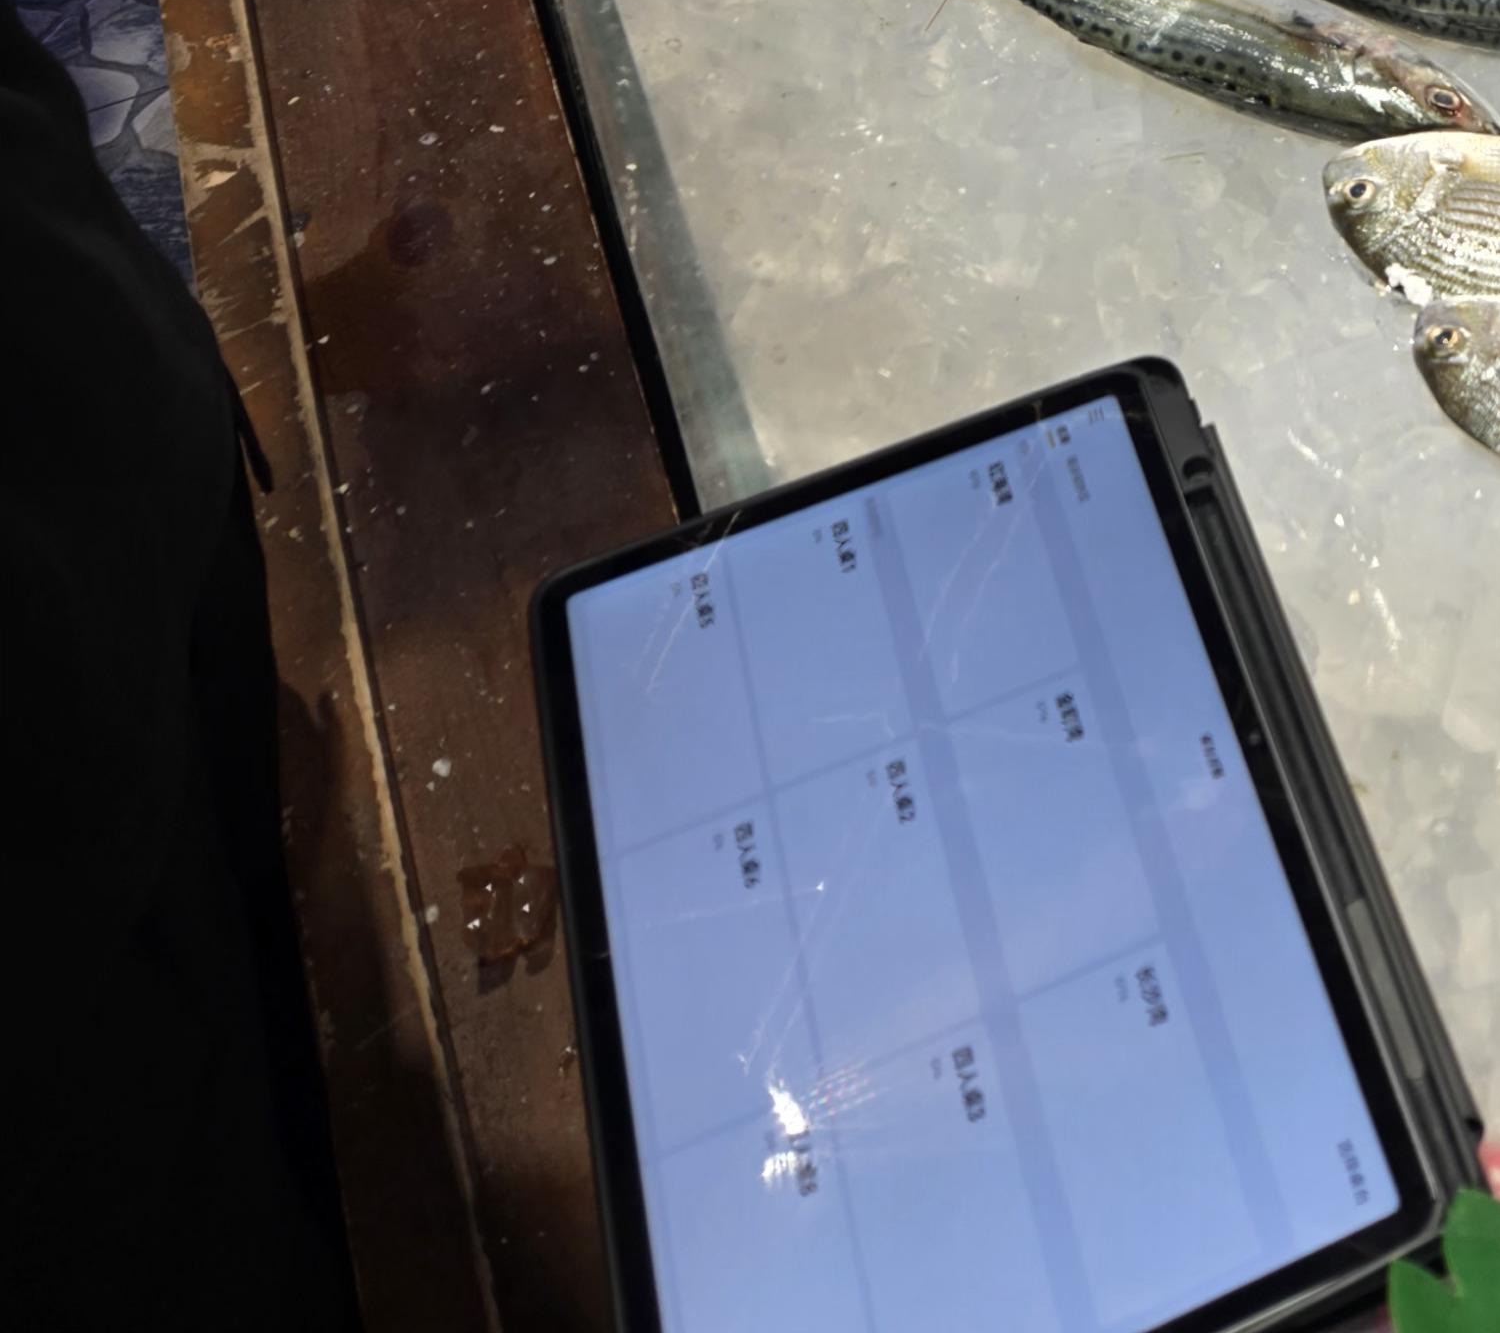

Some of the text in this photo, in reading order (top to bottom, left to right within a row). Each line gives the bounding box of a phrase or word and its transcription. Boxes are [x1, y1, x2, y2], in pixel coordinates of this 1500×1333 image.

[886, 758, 914, 826] 四人桌2
[732, 820, 760, 889] 四人桌6
[952, 1044, 987, 1123] 四人桌3
